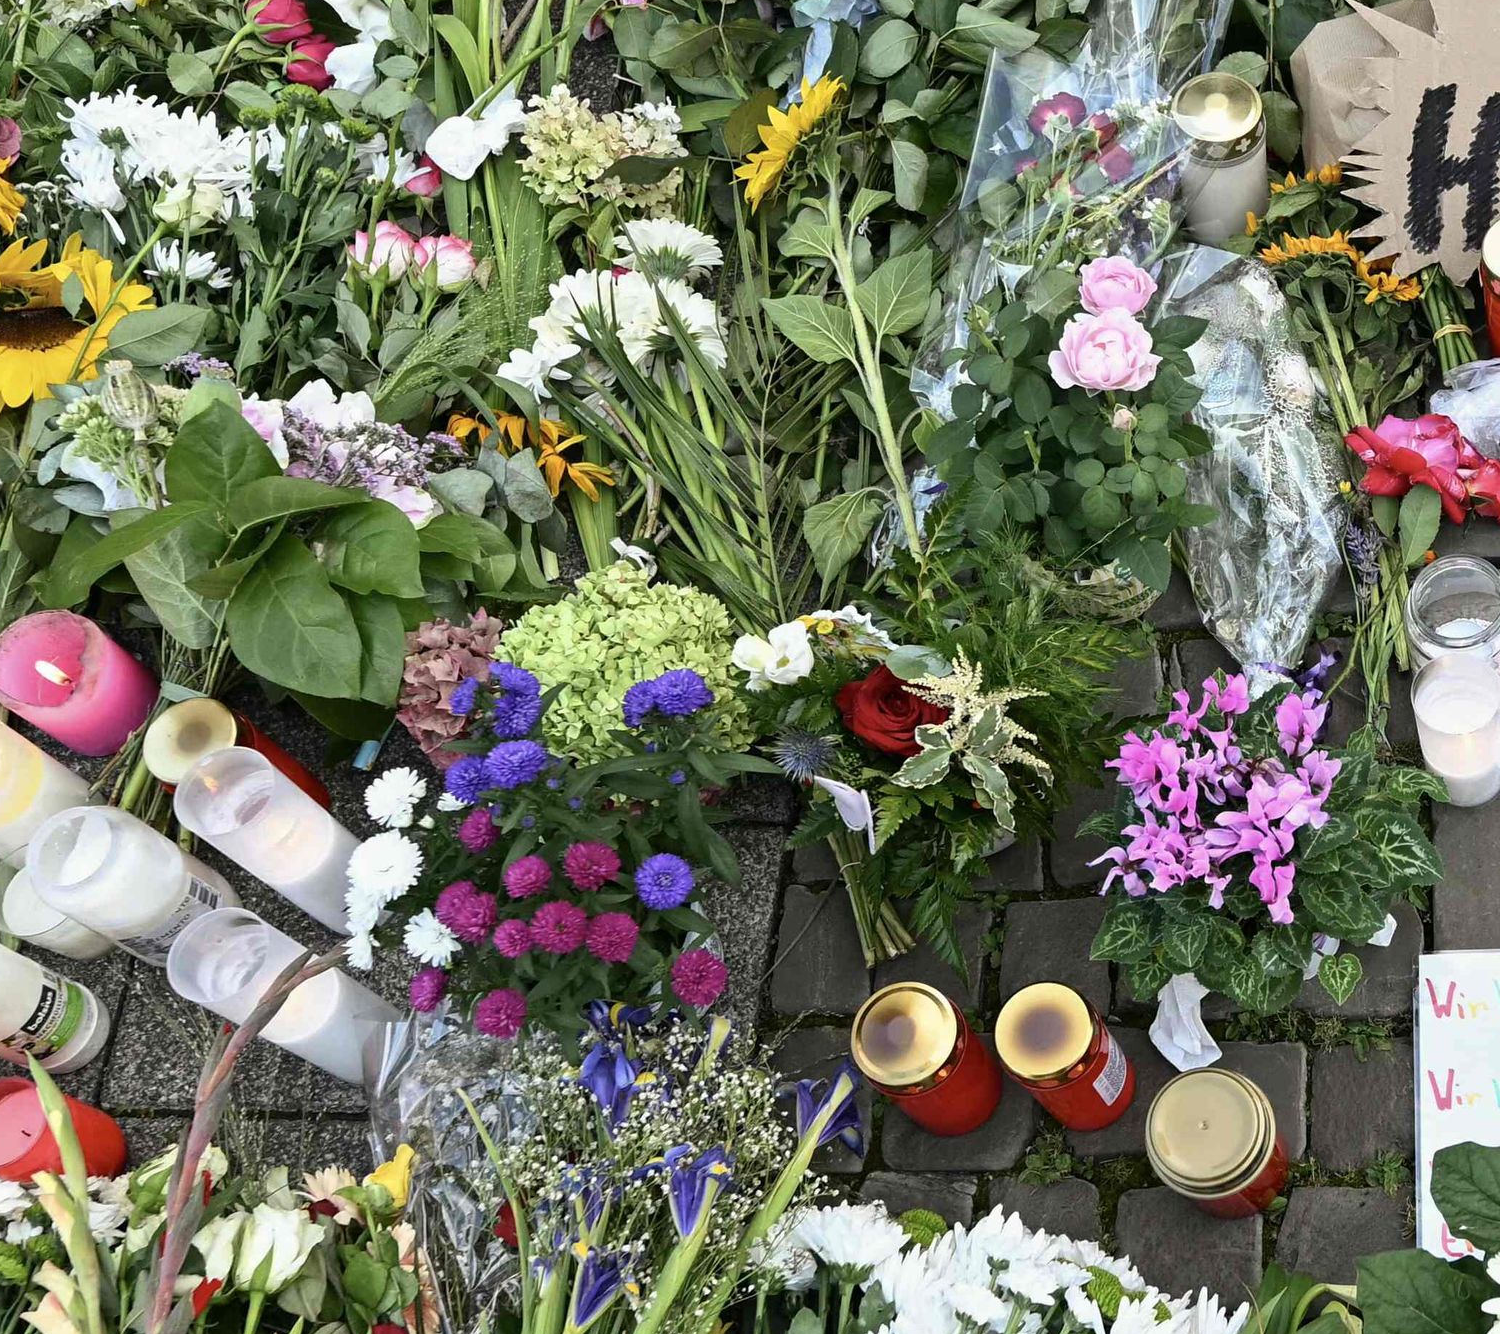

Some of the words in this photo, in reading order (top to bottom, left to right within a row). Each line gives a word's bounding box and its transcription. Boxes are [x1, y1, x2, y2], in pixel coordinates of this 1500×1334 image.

[27, 990, 54, 1033] bolsius
[1426, 978, 1488, 1020] Wir
[1428, 1068, 1481, 1113] Wir
